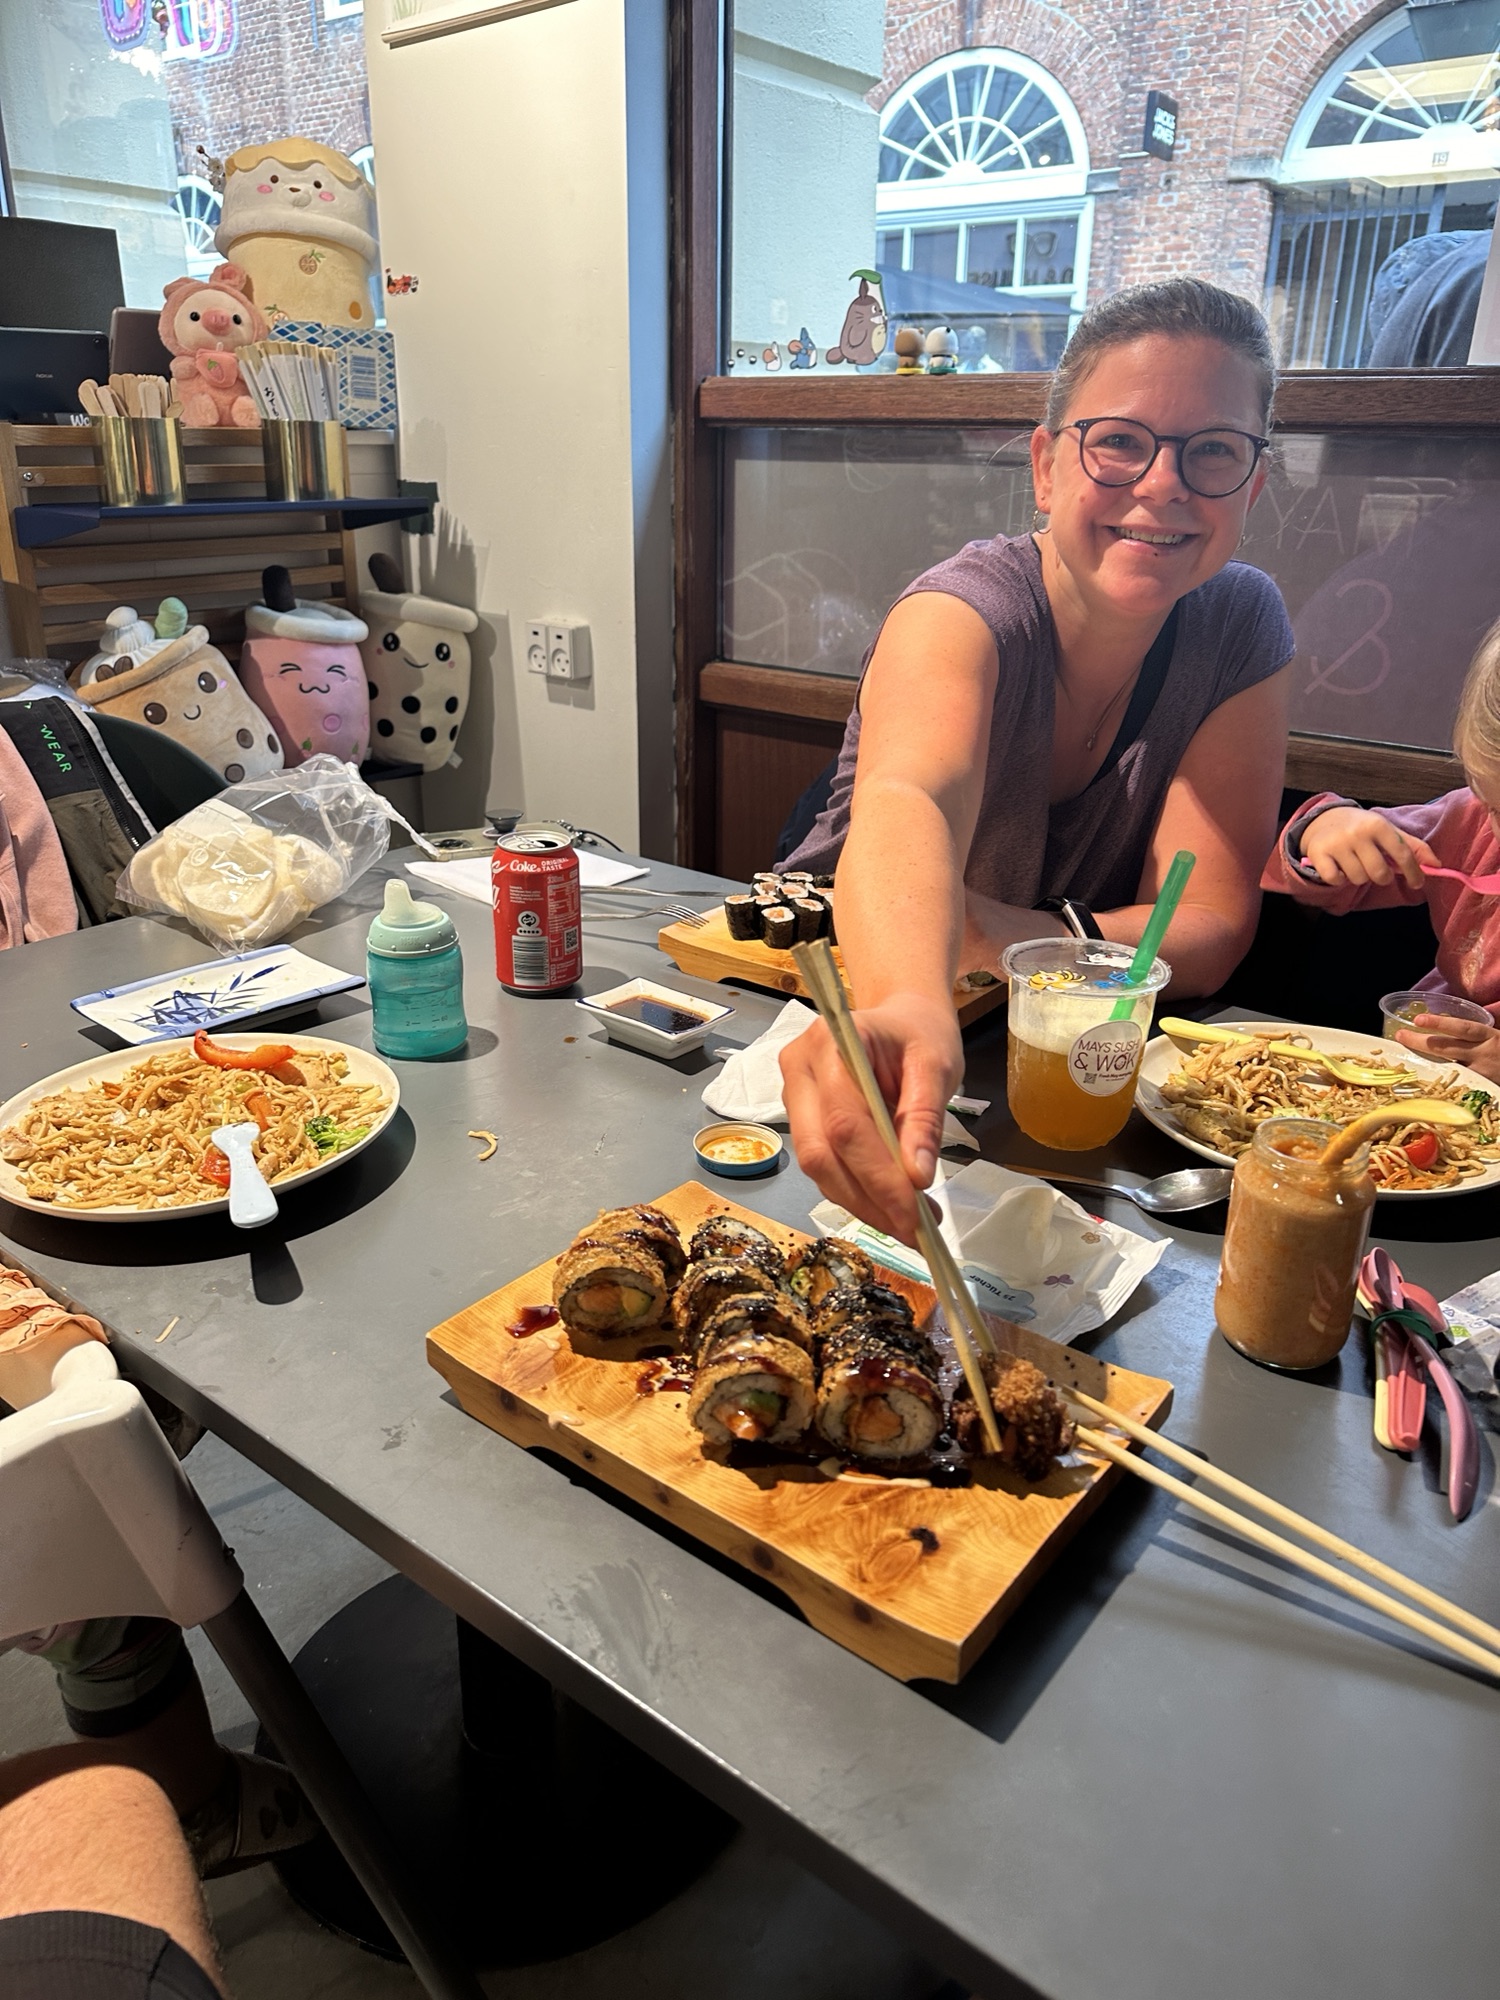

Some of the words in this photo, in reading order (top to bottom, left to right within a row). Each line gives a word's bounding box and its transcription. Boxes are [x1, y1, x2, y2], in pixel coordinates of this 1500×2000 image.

[509, 859, 538, 873] Coke
[541, 857, 569, 867] ORIGINAL
[541, 864, 563, 872] TASTE
[1078, 1039, 1112, 1054] MAYS
[1113, 1039, 1141, 1054] SUSH
[1074, 1051, 1089, 1071] &
[1096, 1050, 1138, 1072] WOK
